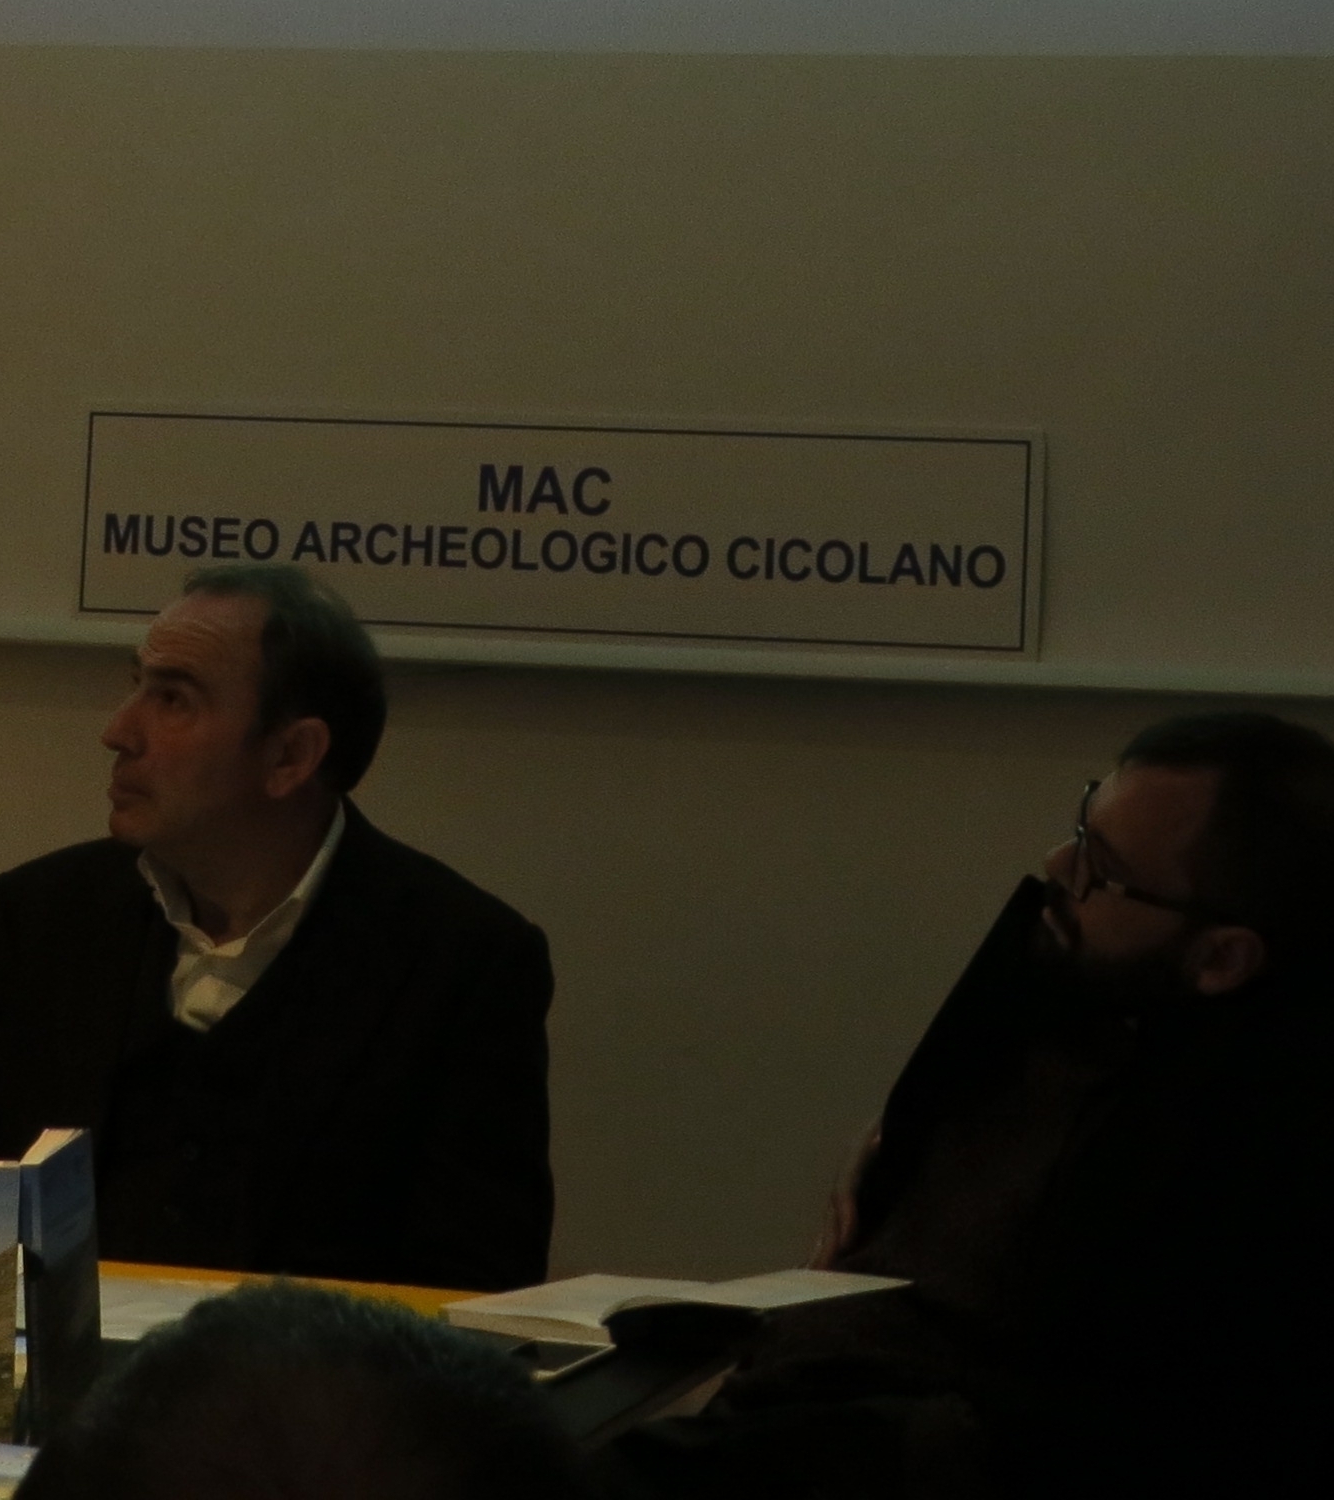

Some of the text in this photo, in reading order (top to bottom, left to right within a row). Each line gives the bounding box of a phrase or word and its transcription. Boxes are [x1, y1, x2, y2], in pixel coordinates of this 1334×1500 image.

[477, 463, 613, 517] MAC
[102, 512, 1007, 590] MUSEO ARCHEOLOGICO CICOLANO
